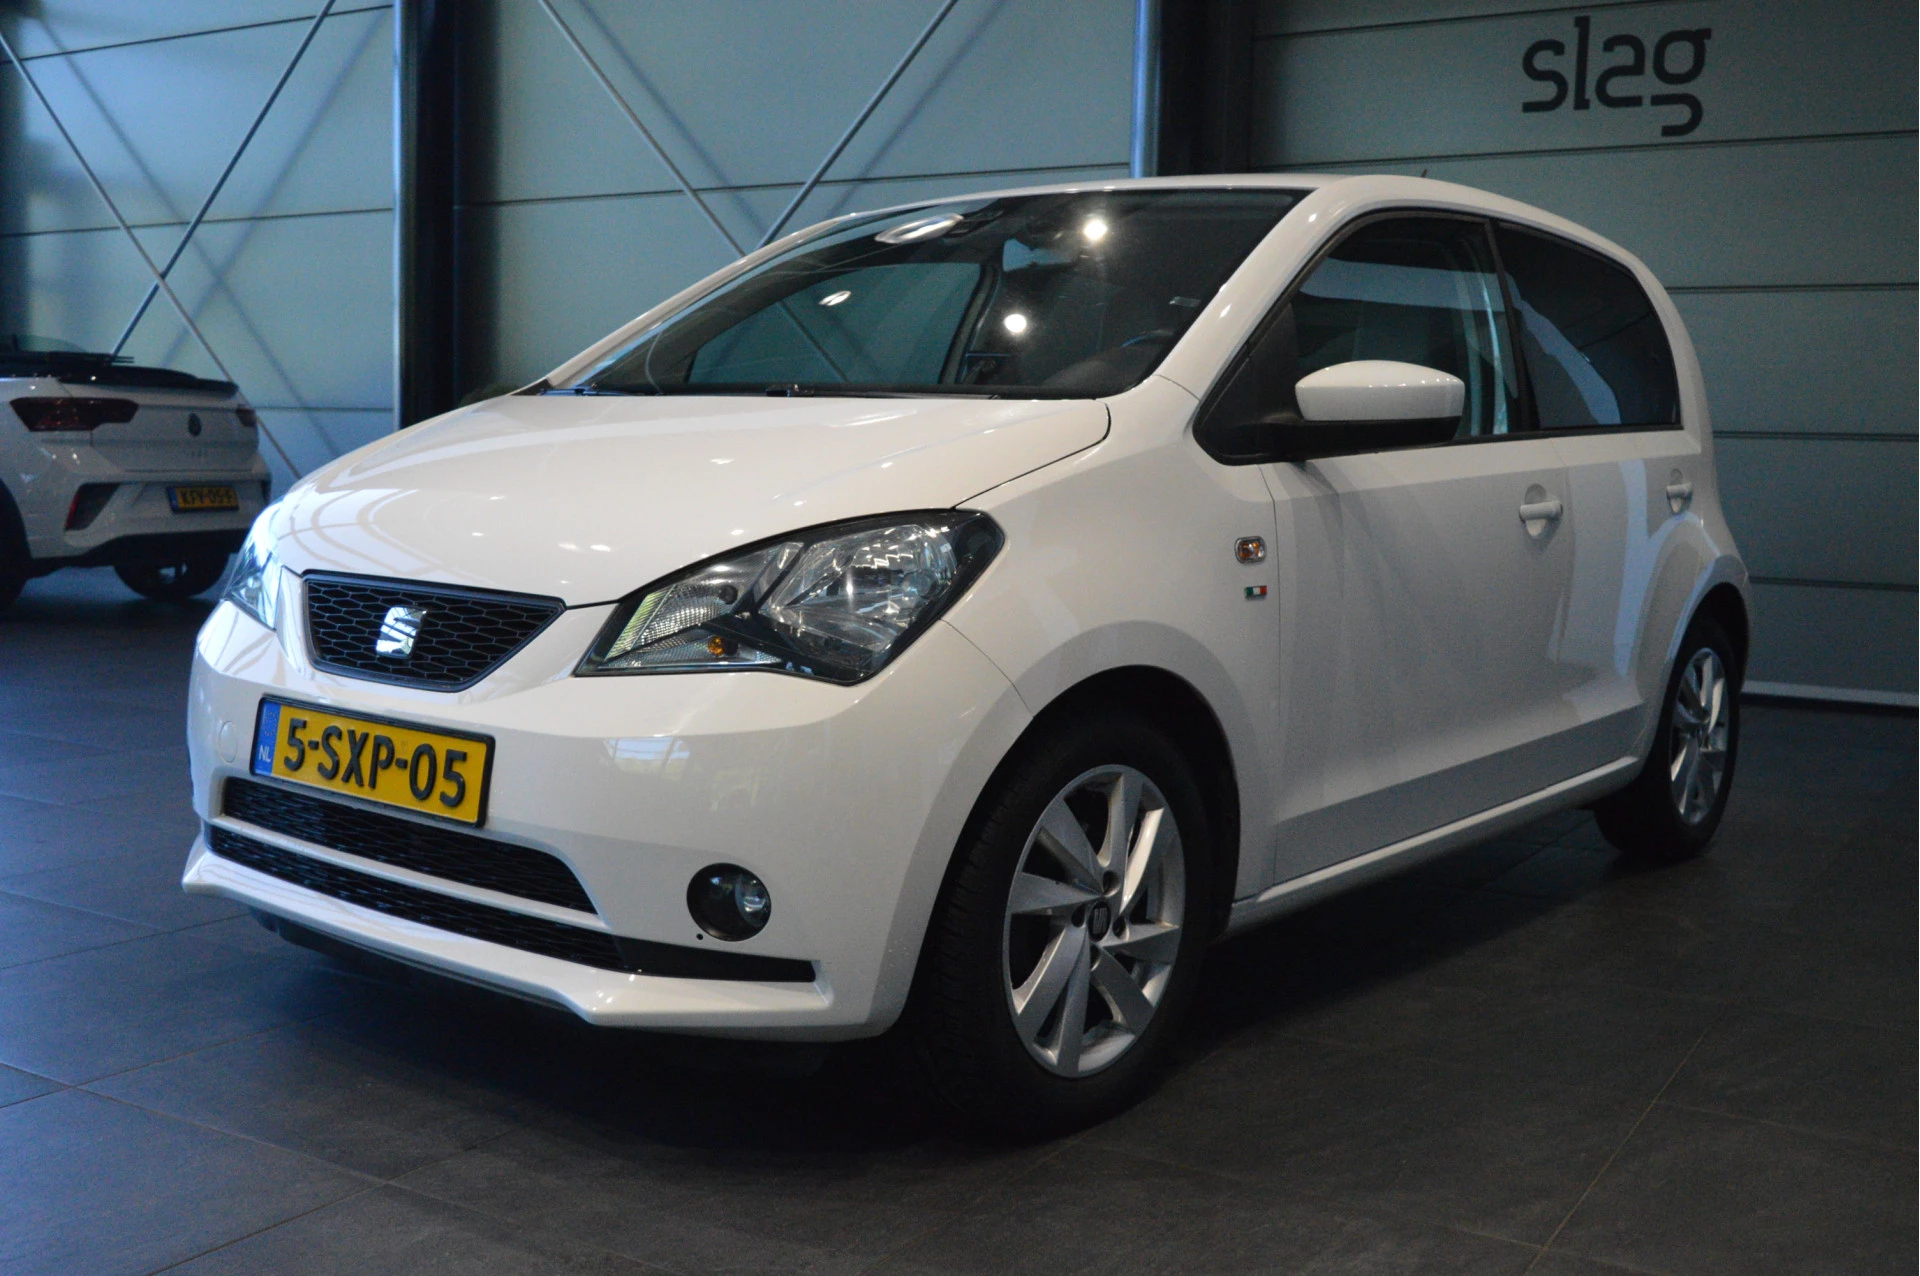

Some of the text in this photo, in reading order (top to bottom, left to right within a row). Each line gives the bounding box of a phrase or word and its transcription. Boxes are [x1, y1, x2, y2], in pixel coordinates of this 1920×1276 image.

[1522, 15, 1712, 137] slag
[259, 744, 271, 763] NL
[284, 717, 468, 808] 5-SXP-05
